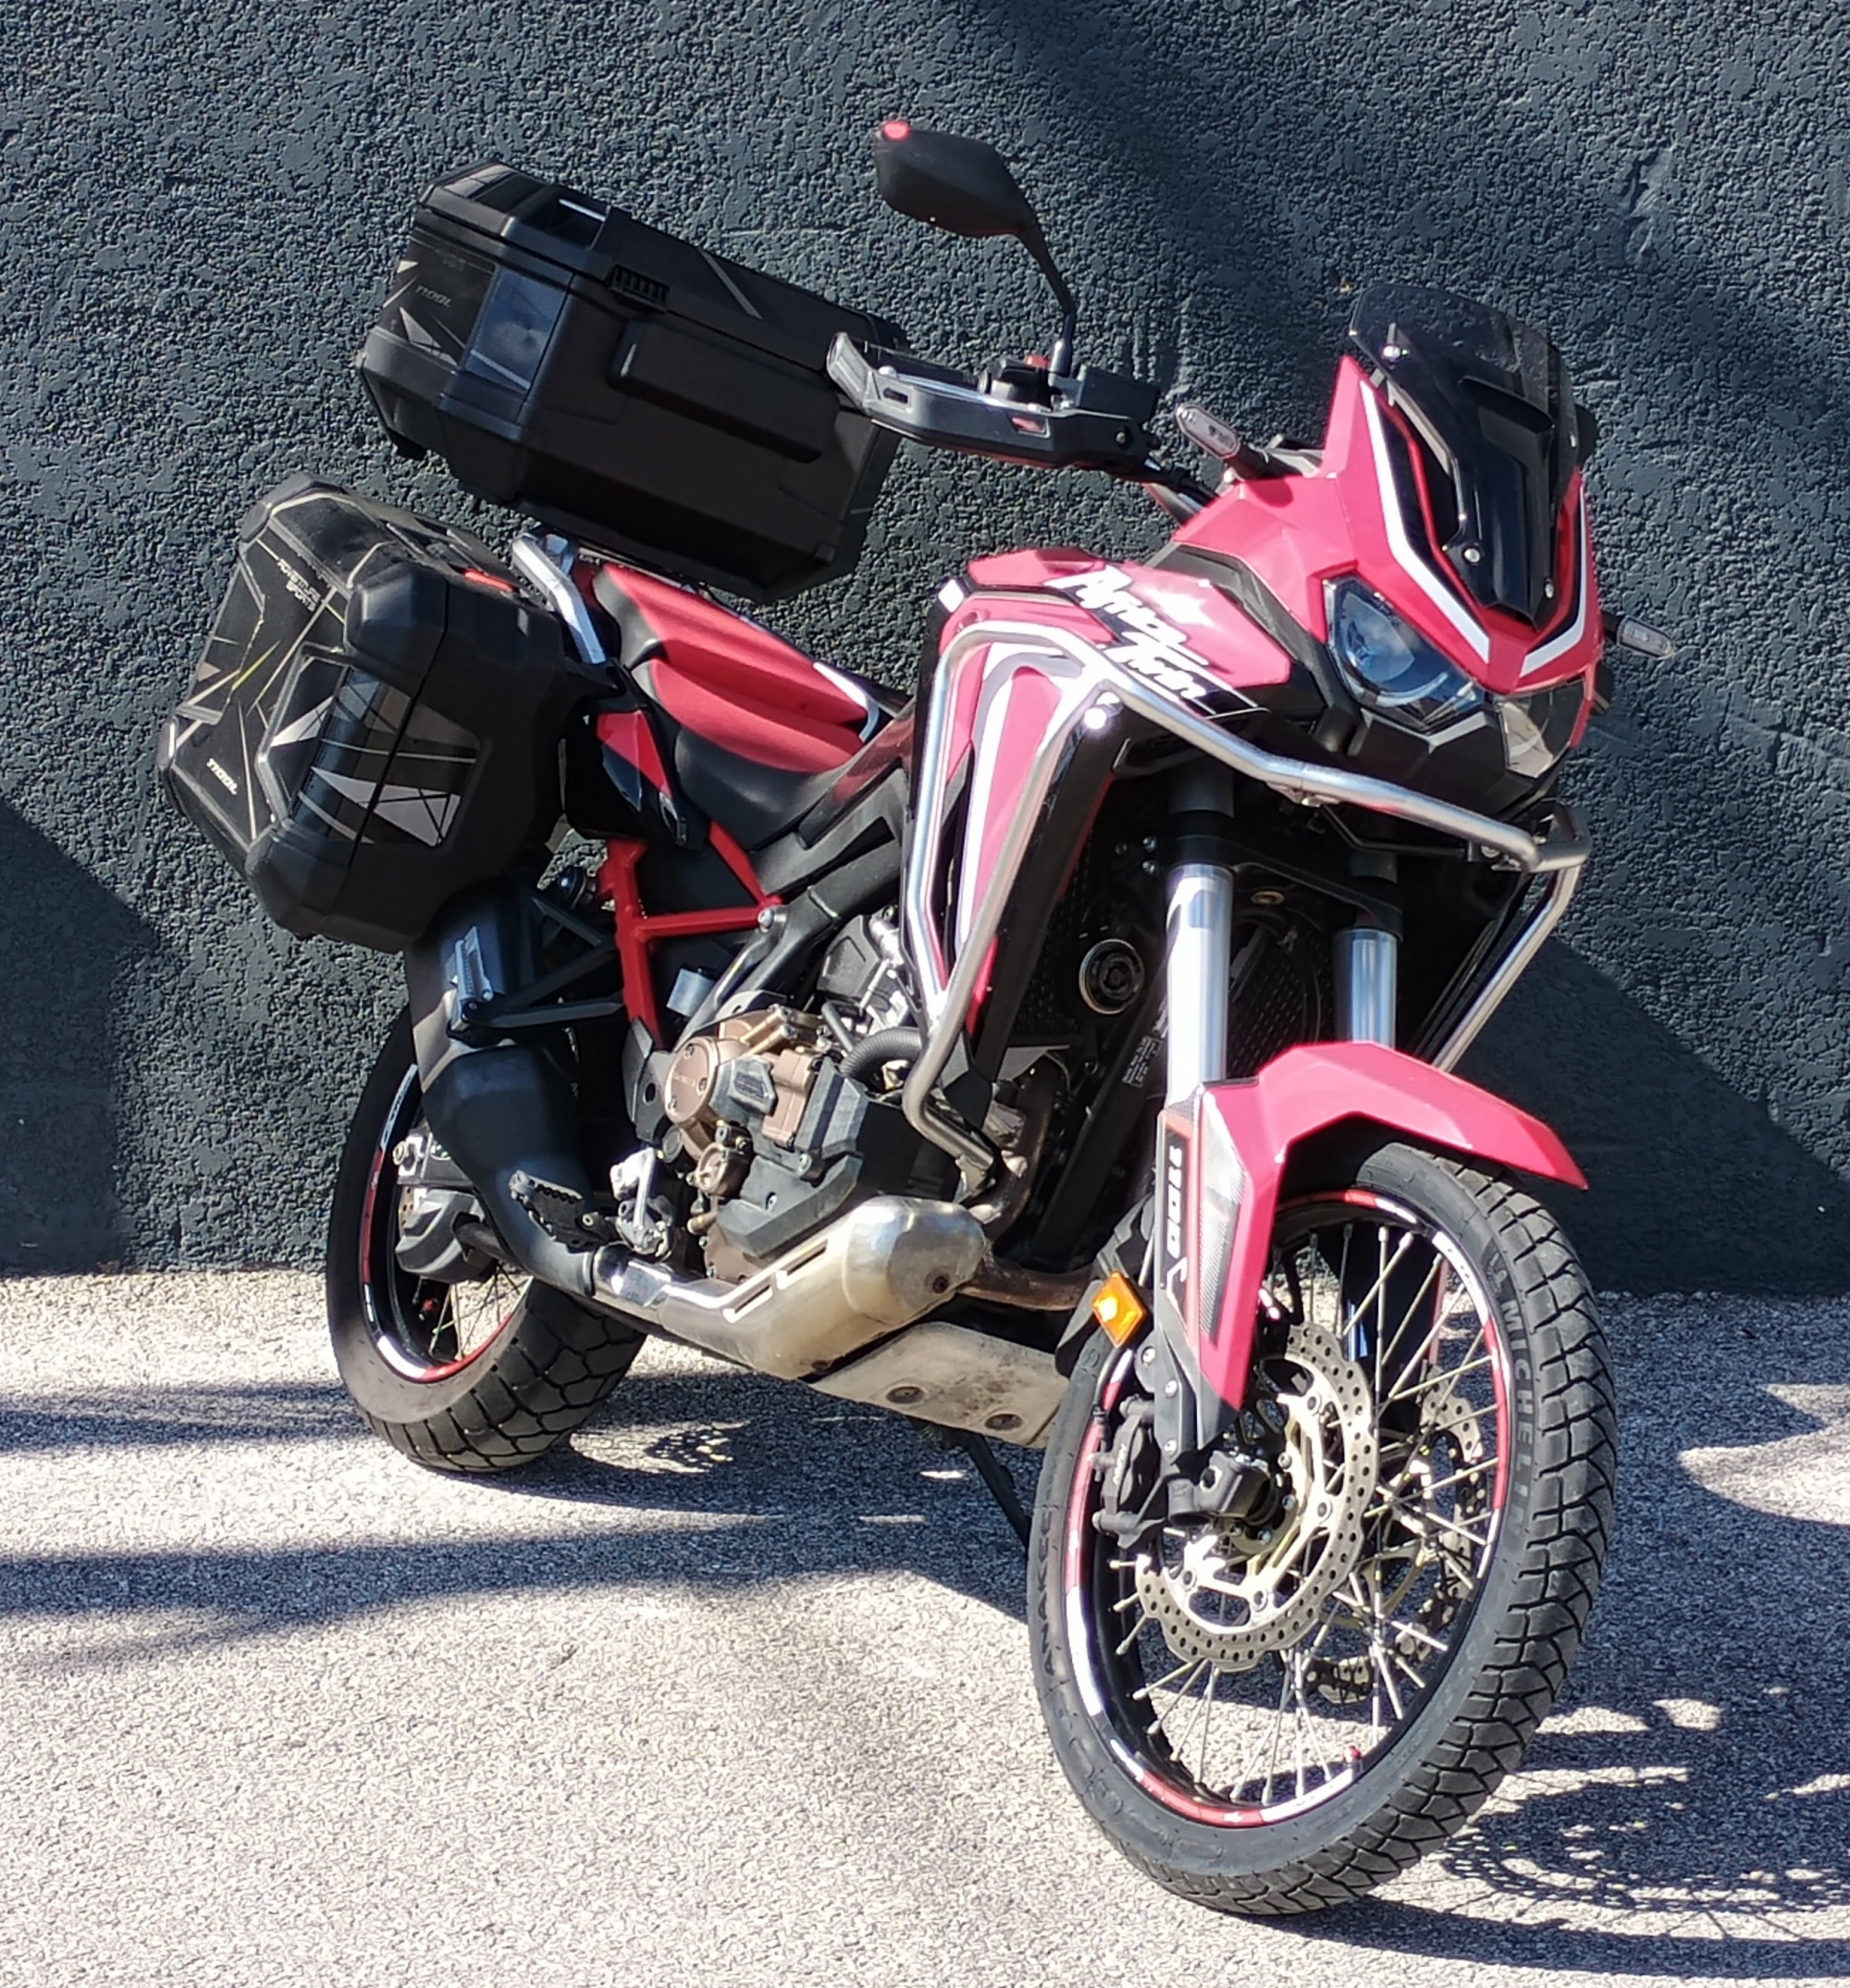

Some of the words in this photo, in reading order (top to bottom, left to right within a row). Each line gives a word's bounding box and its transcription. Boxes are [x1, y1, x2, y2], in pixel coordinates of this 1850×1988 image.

[1166, 1144, 1183, 1259] 1100
[1500, 1297, 1534, 1536] MICHELIN
[1037, 1510, 1056, 1677] ANAKEE
